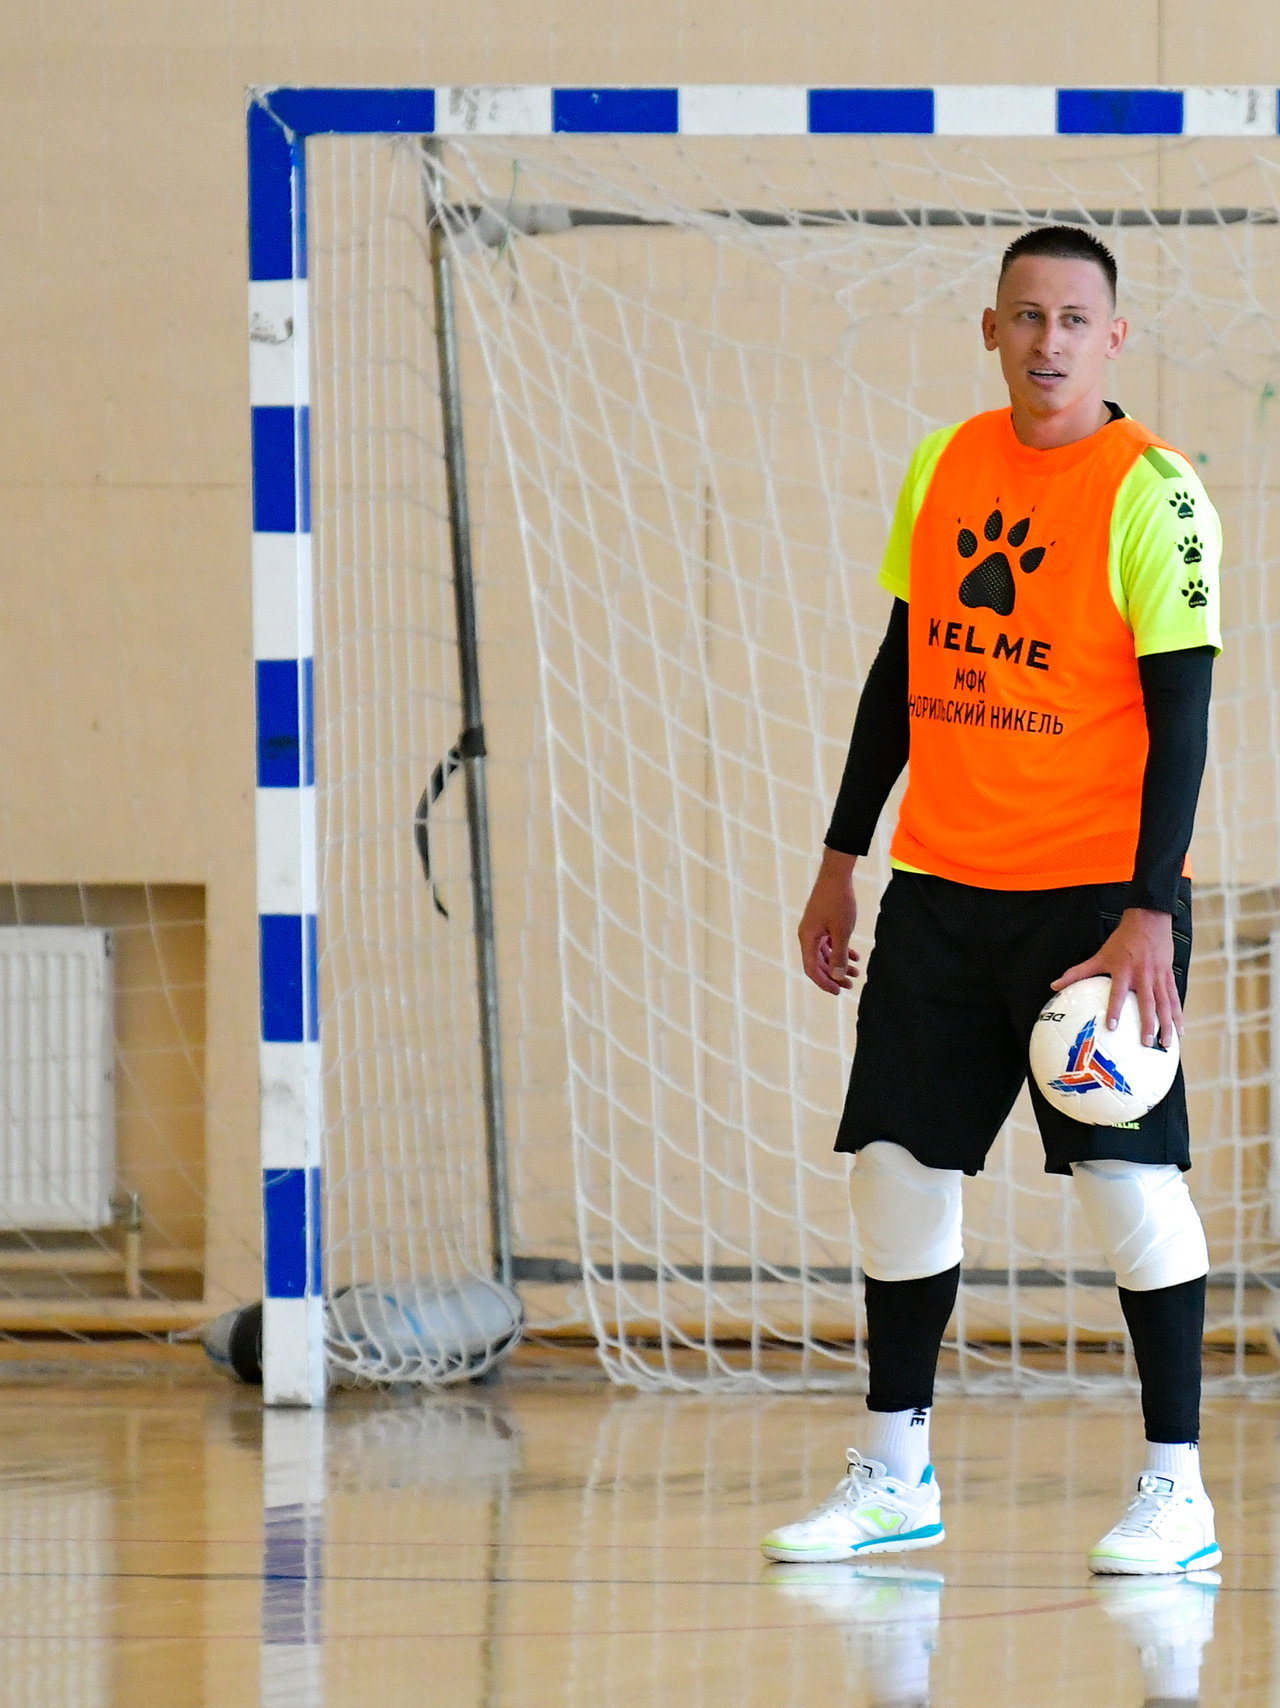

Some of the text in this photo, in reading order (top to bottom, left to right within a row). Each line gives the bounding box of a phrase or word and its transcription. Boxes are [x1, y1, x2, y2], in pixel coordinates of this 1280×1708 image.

[928, 617, 1052, 671] KELME
[953, 667, 987, 694] МФК
[990, 705, 1065, 736] НИКЕЛЬ
